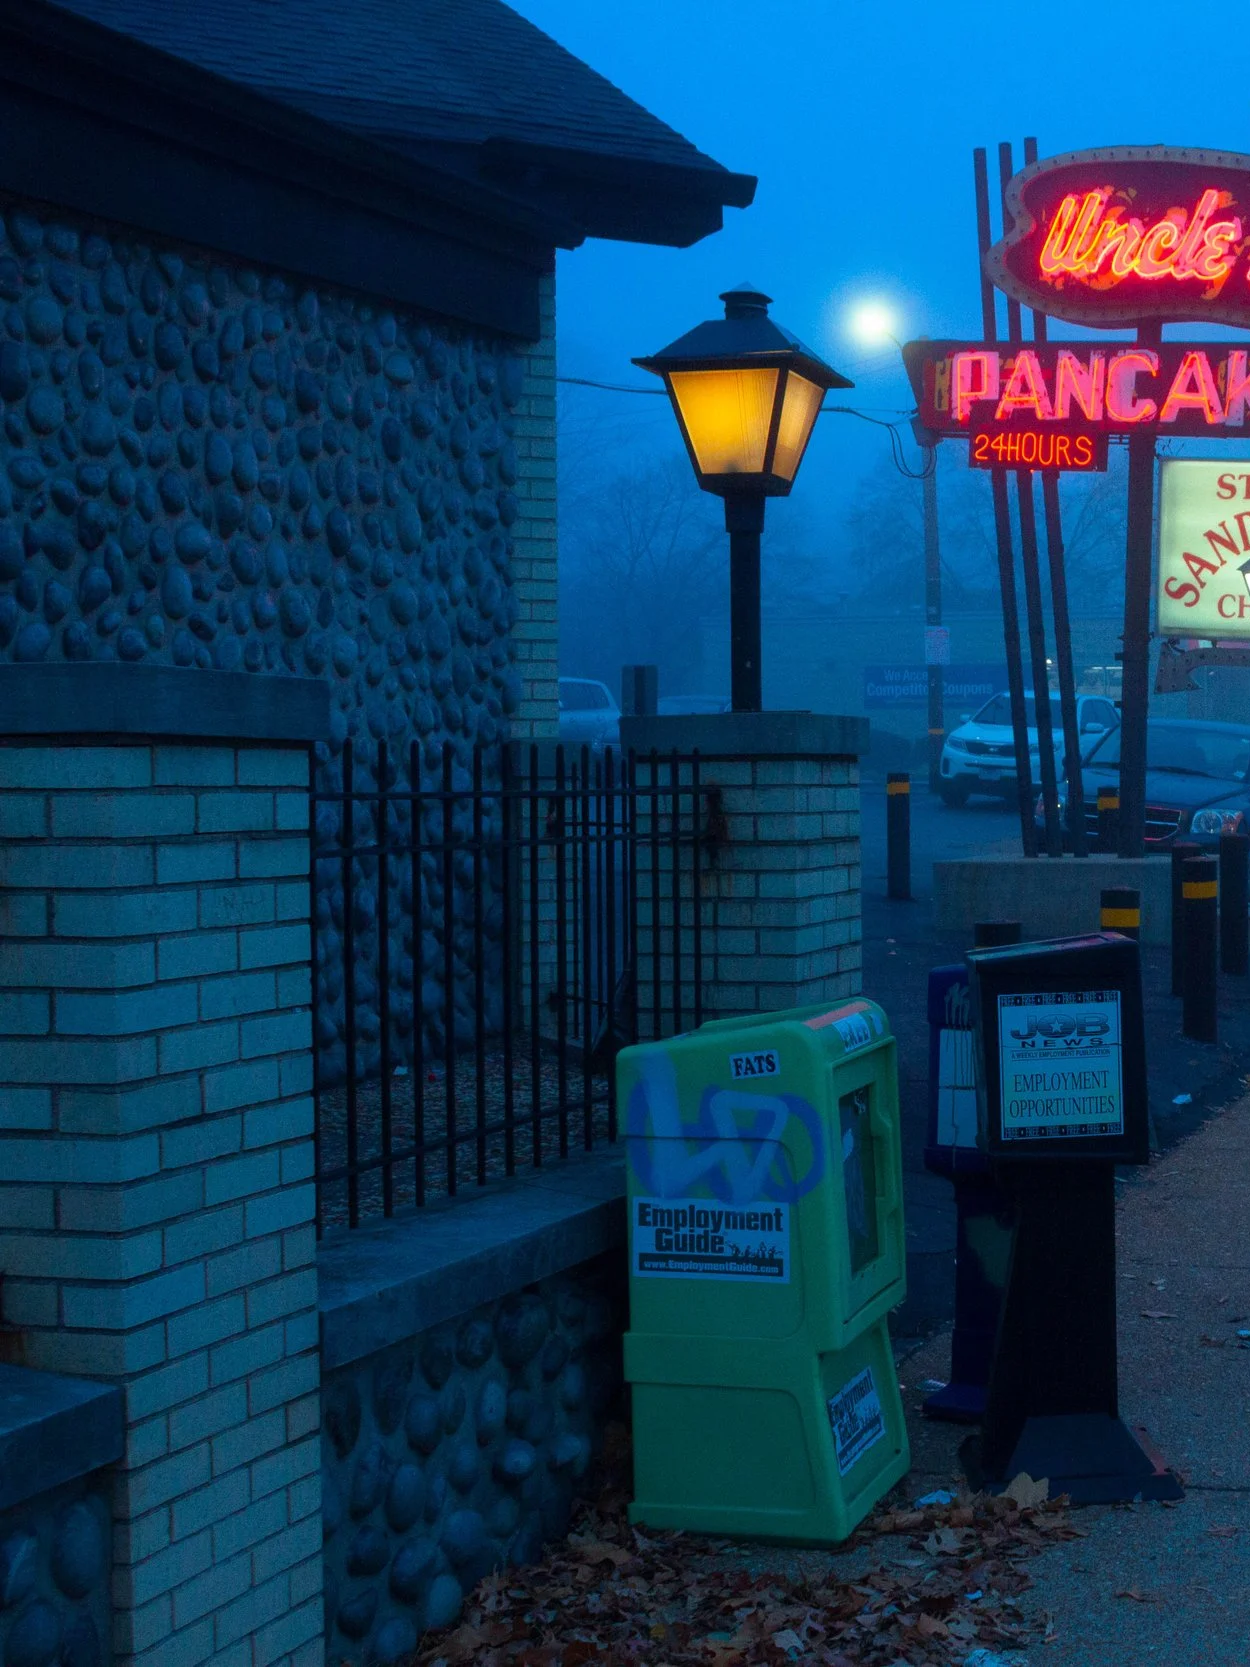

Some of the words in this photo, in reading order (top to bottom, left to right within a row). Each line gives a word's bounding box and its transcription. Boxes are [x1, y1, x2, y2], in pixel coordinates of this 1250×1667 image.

[1039, 187, 1240, 282] Uncle
[973, 431, 1095, 467] 24HOURS
[902, 669, 929, 682] Acce
[1010, 1012, 1111, 1040] JOB
[1021, 1038, 1104, 1049] NEWS
[733, 1054, 777, 1077] FATS
[1014, 1070, 1109, 1093] EMPLOYMENT
[1009, 1095, 1115, 1118] OPPORTUNITIES
[638, 1203, 783, 1233] Employment
[655, 1228, 725, 1254] Guide
[644, 1260, 779, 1273] www.EmploymentGuide.com
